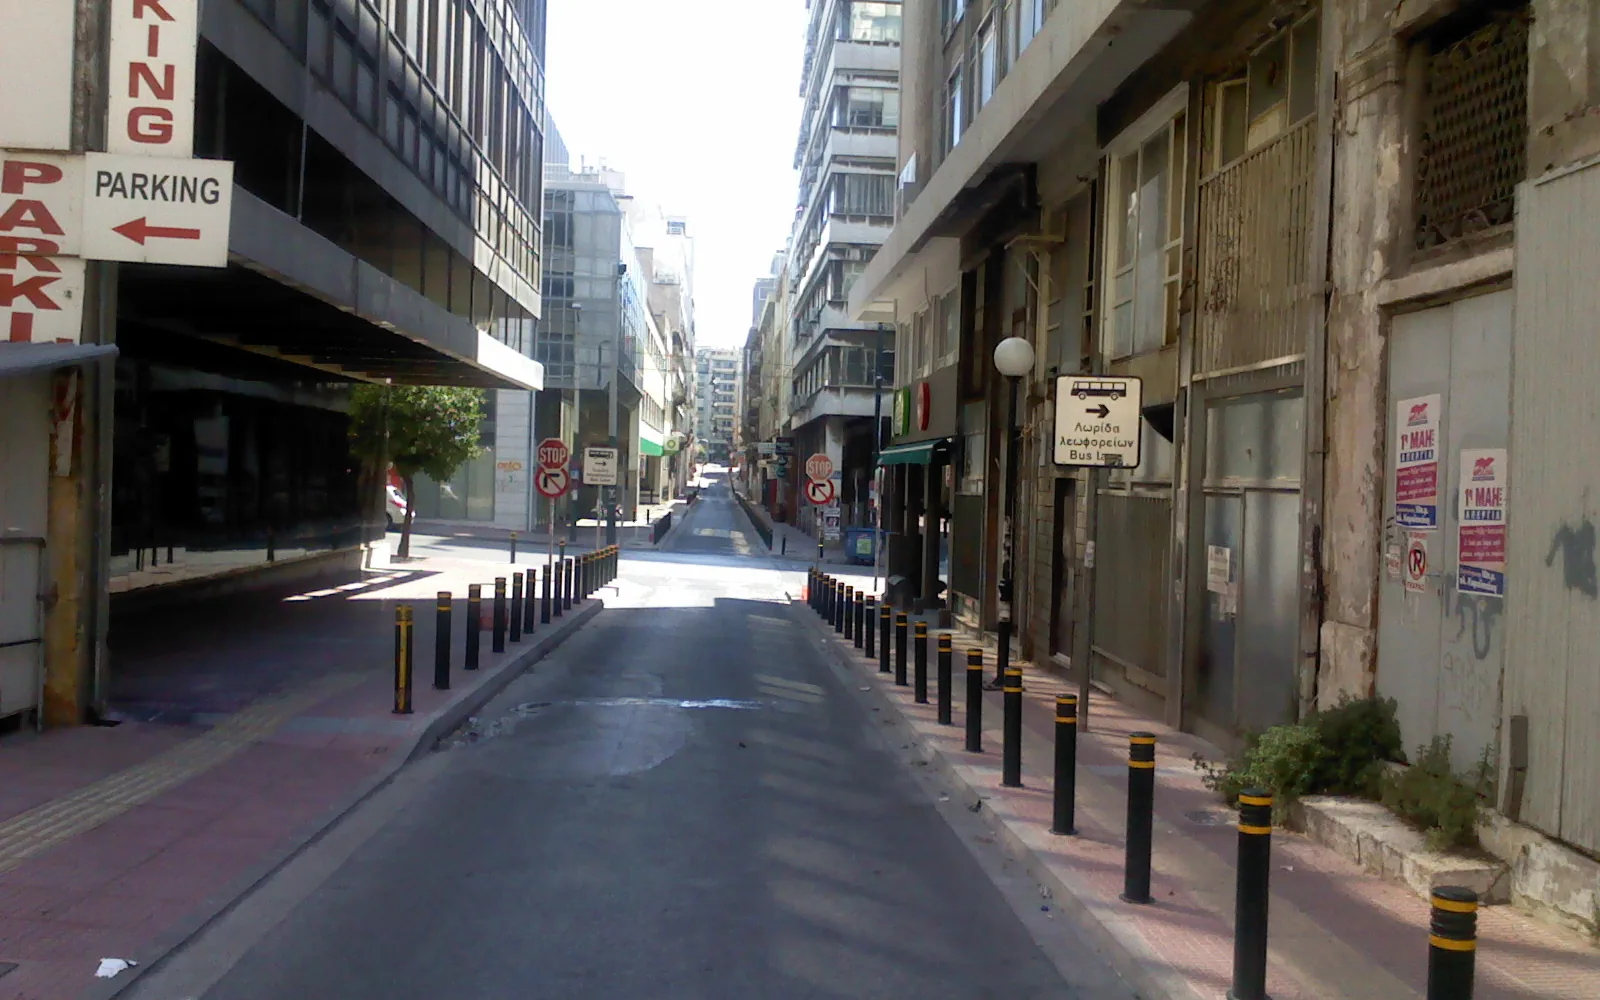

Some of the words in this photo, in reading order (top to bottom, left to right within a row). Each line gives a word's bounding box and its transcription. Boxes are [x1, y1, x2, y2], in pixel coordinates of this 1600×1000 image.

[95, 170, 220, 205] PARKING
[1074, 422, 1120, 435] Λωρίδα
[1060, 436, 1134, 449] λεωφορείων
[539, 447, 566, 464] STOP
[1069, 449, 1092, 460] Bus
[808, 461, 832, 475] STOP
